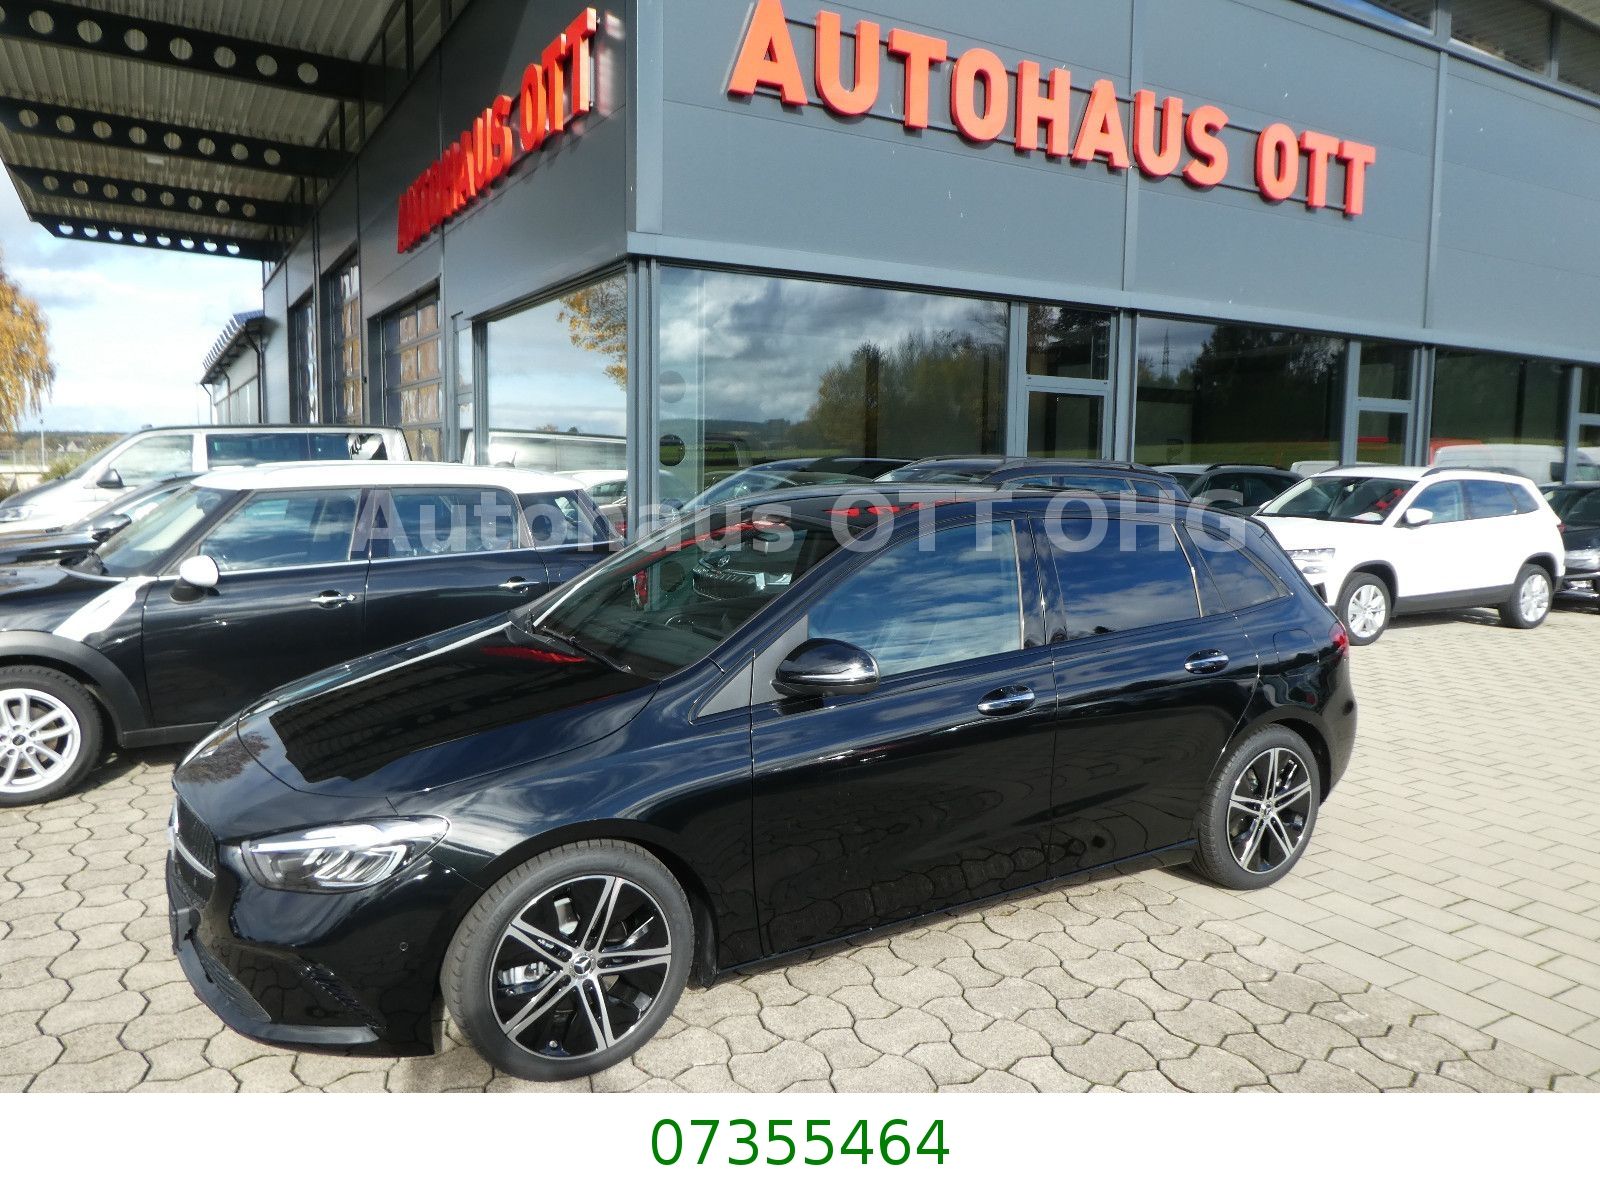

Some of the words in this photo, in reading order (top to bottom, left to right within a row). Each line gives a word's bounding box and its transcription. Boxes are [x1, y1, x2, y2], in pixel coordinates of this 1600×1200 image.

[519, 7, 597, 152] OTT
[727, 0, 1229, 188] AUTOHAUS
[1255, 123, 1376, 216] OTT
